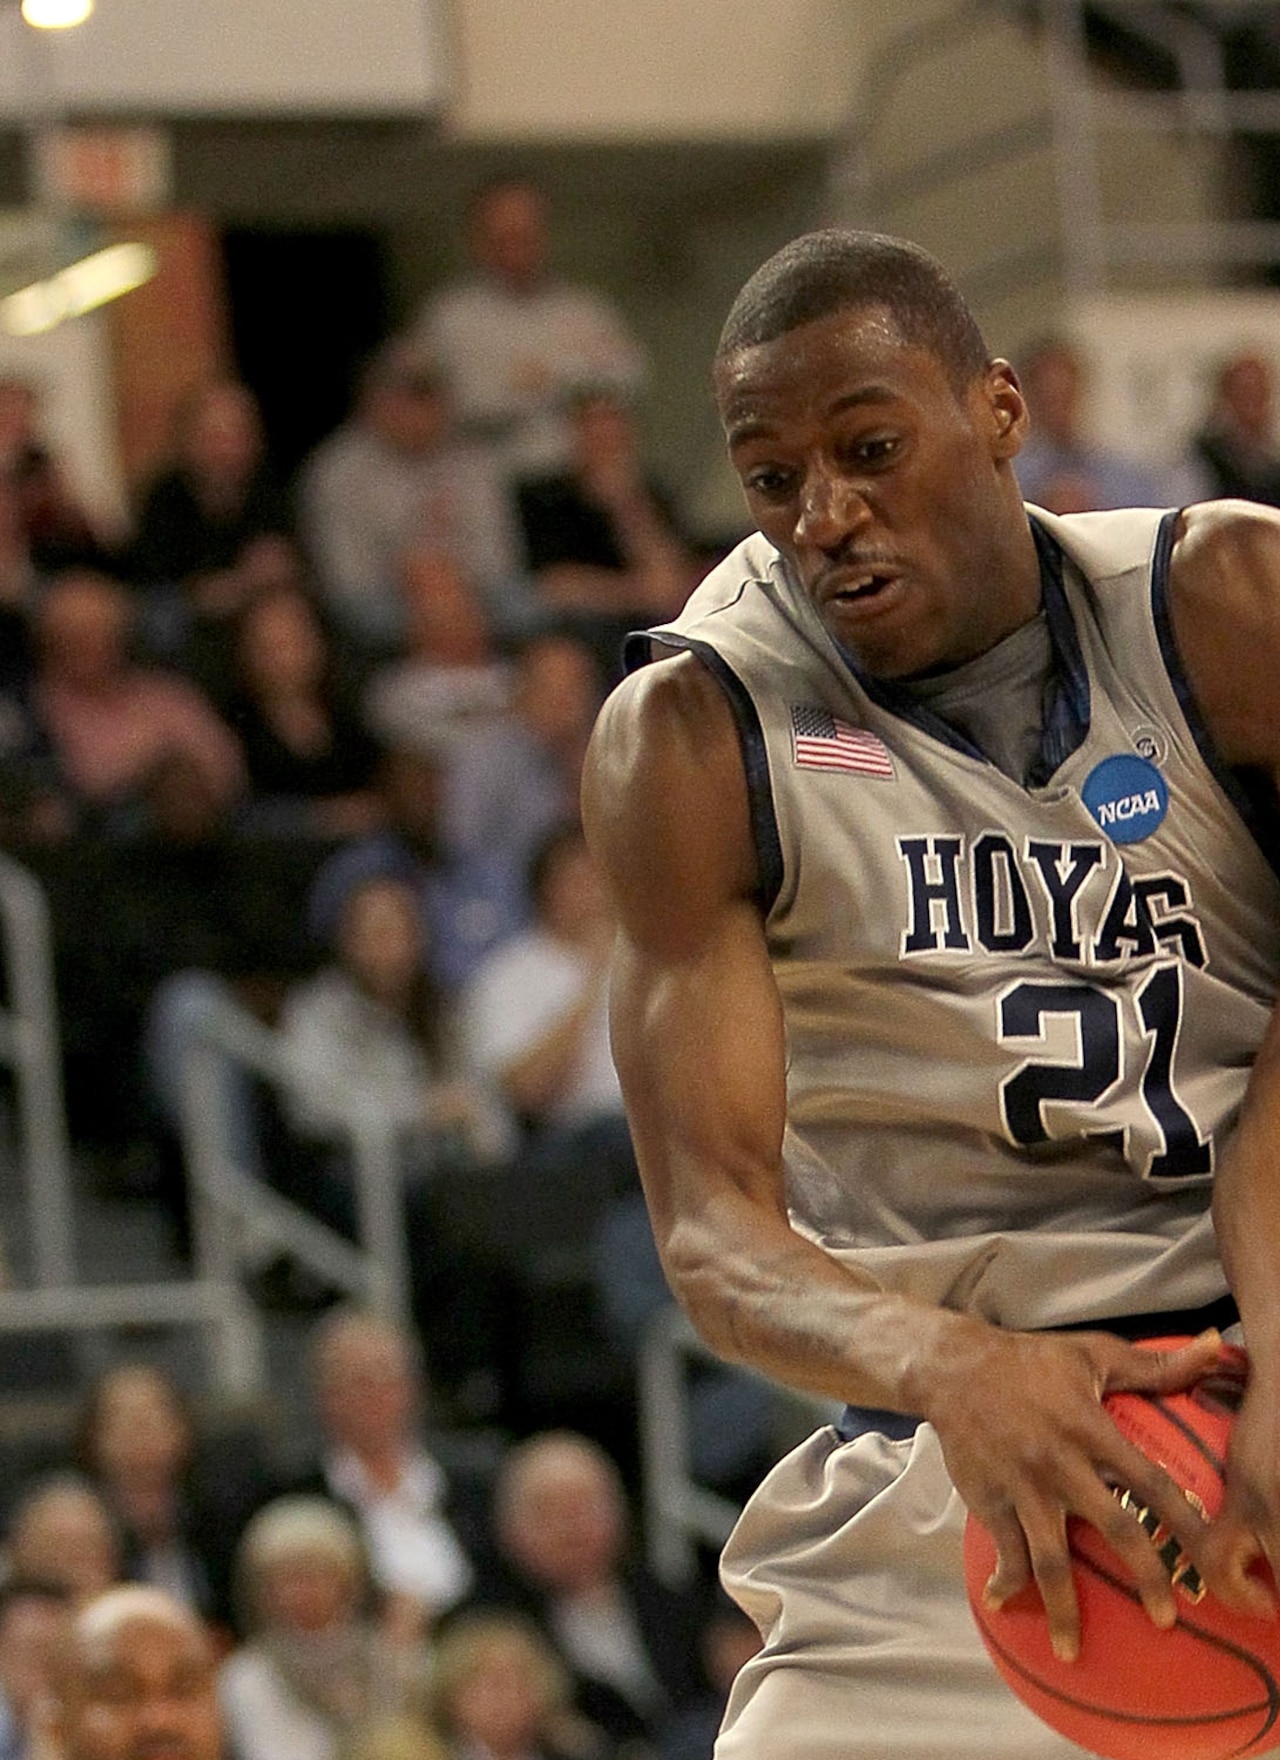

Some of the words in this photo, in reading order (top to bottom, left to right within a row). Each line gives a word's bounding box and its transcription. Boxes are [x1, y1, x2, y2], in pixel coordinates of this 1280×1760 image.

[1097, 789, 1161, 827] NCAA
[894, 829, 1210, 971] HOYAS
[997, 957, 1216, 1181] 21
